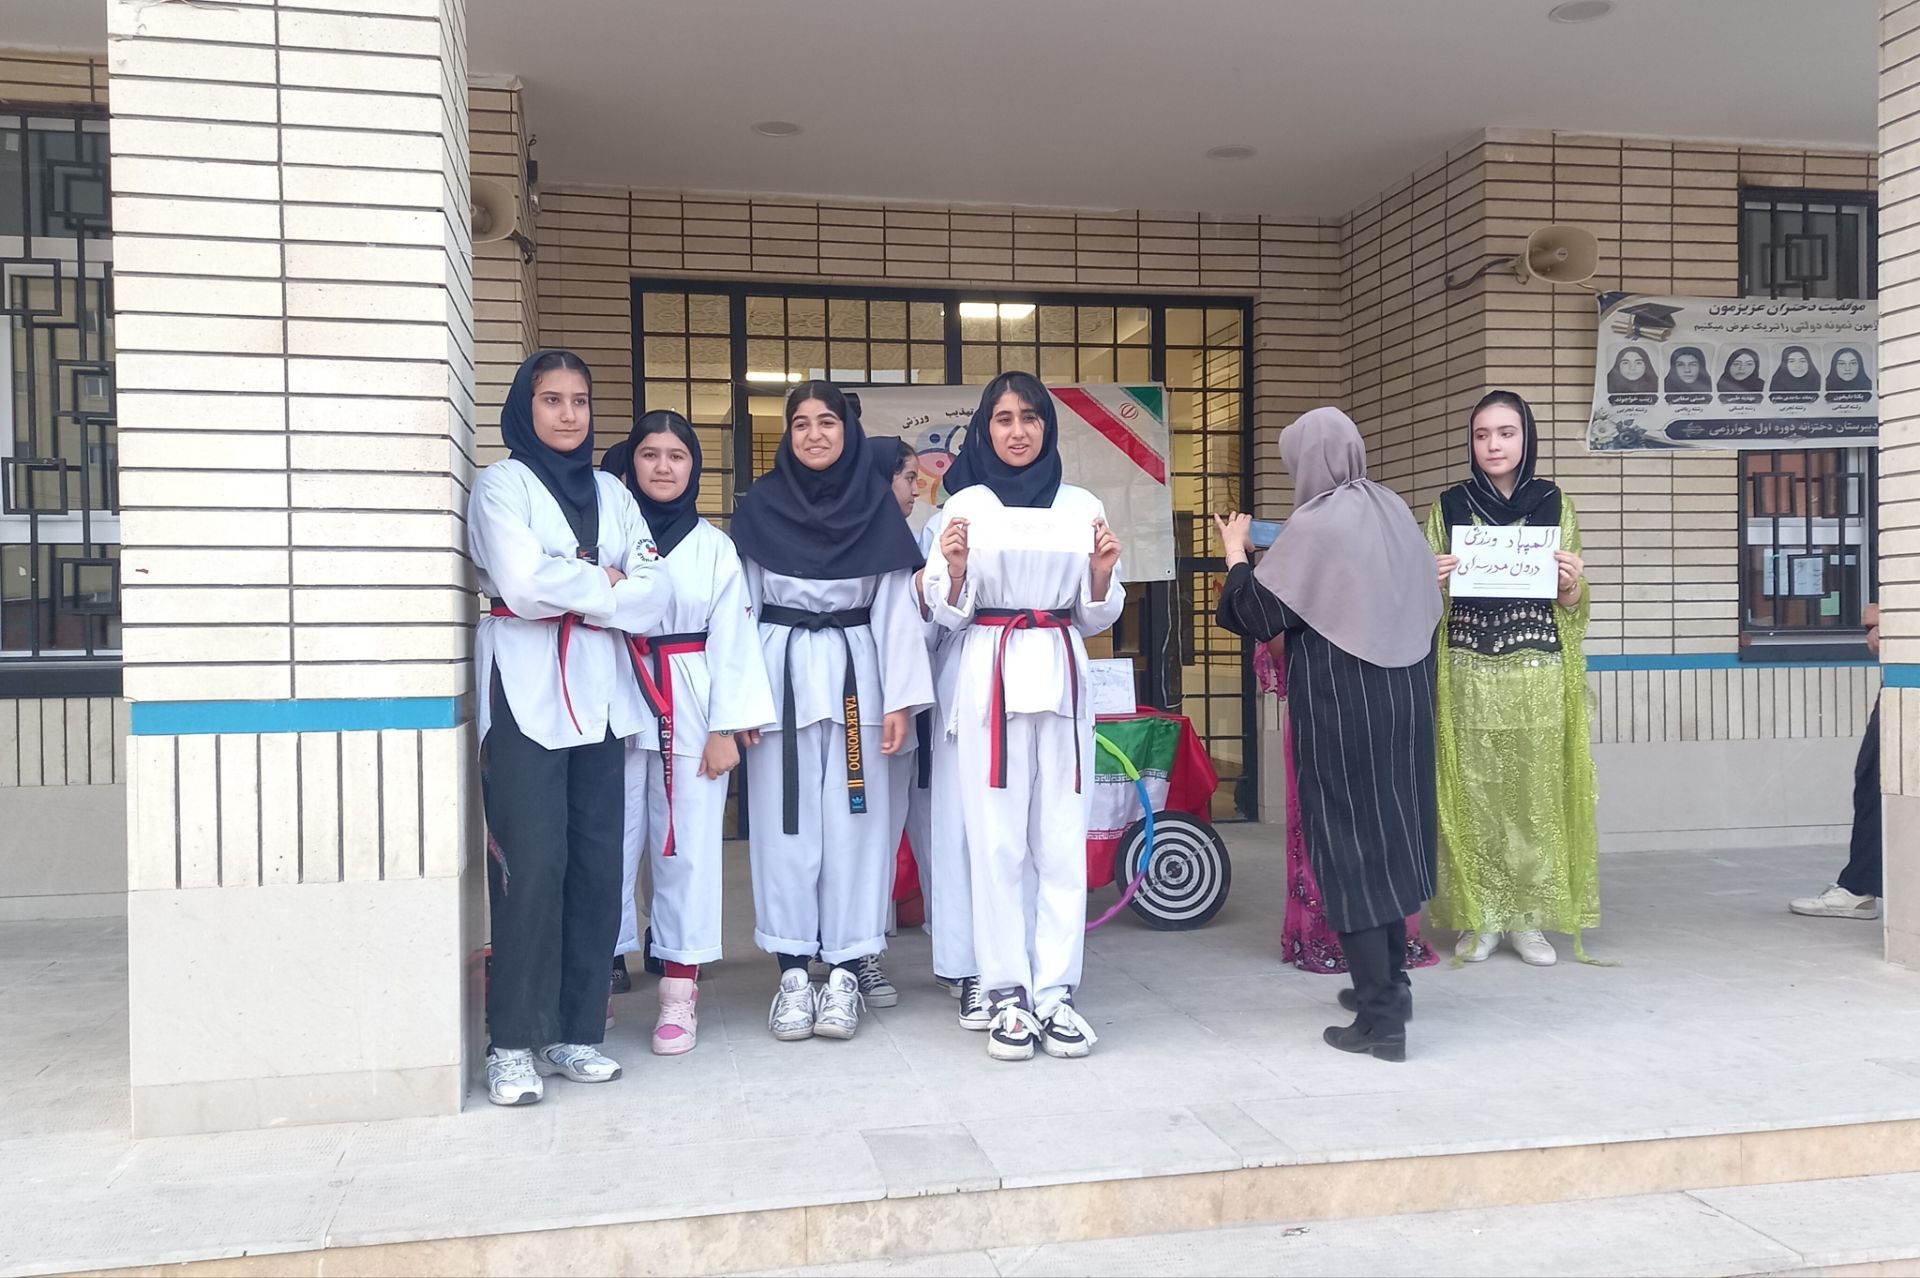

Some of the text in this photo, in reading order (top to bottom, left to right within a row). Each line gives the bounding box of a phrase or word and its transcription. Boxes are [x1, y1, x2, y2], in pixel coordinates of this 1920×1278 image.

[1709, 301, 1866, 316] موفقیت دختران عزیزمون
[1694, 322, 1724, 332] میکنیم
[1726, 323, 1750, 332] عرض
[1752, 323, 1780, 333] تبریک
[1780, 322, 1789, 333] را
[1791, 321, 1822, 333] دولتی
[1824, 320, 1852, 333] نمونه
[945, 407, 975, 418] تهذیب
[902, 415, 930, 429] ورزش
[1798, 421, 1833, 434] دخترانه
[1835, 421, 1879, 433] دبیرستان
[1708, 423, 1753, 436] خوارزمی
[1754, 422, 1772, 435] اول
[1774, 423, 1796, 434] دوره
[1510, 562, 1540, 576] درون
[845, 695, 861, 771] TAEKWONDO
